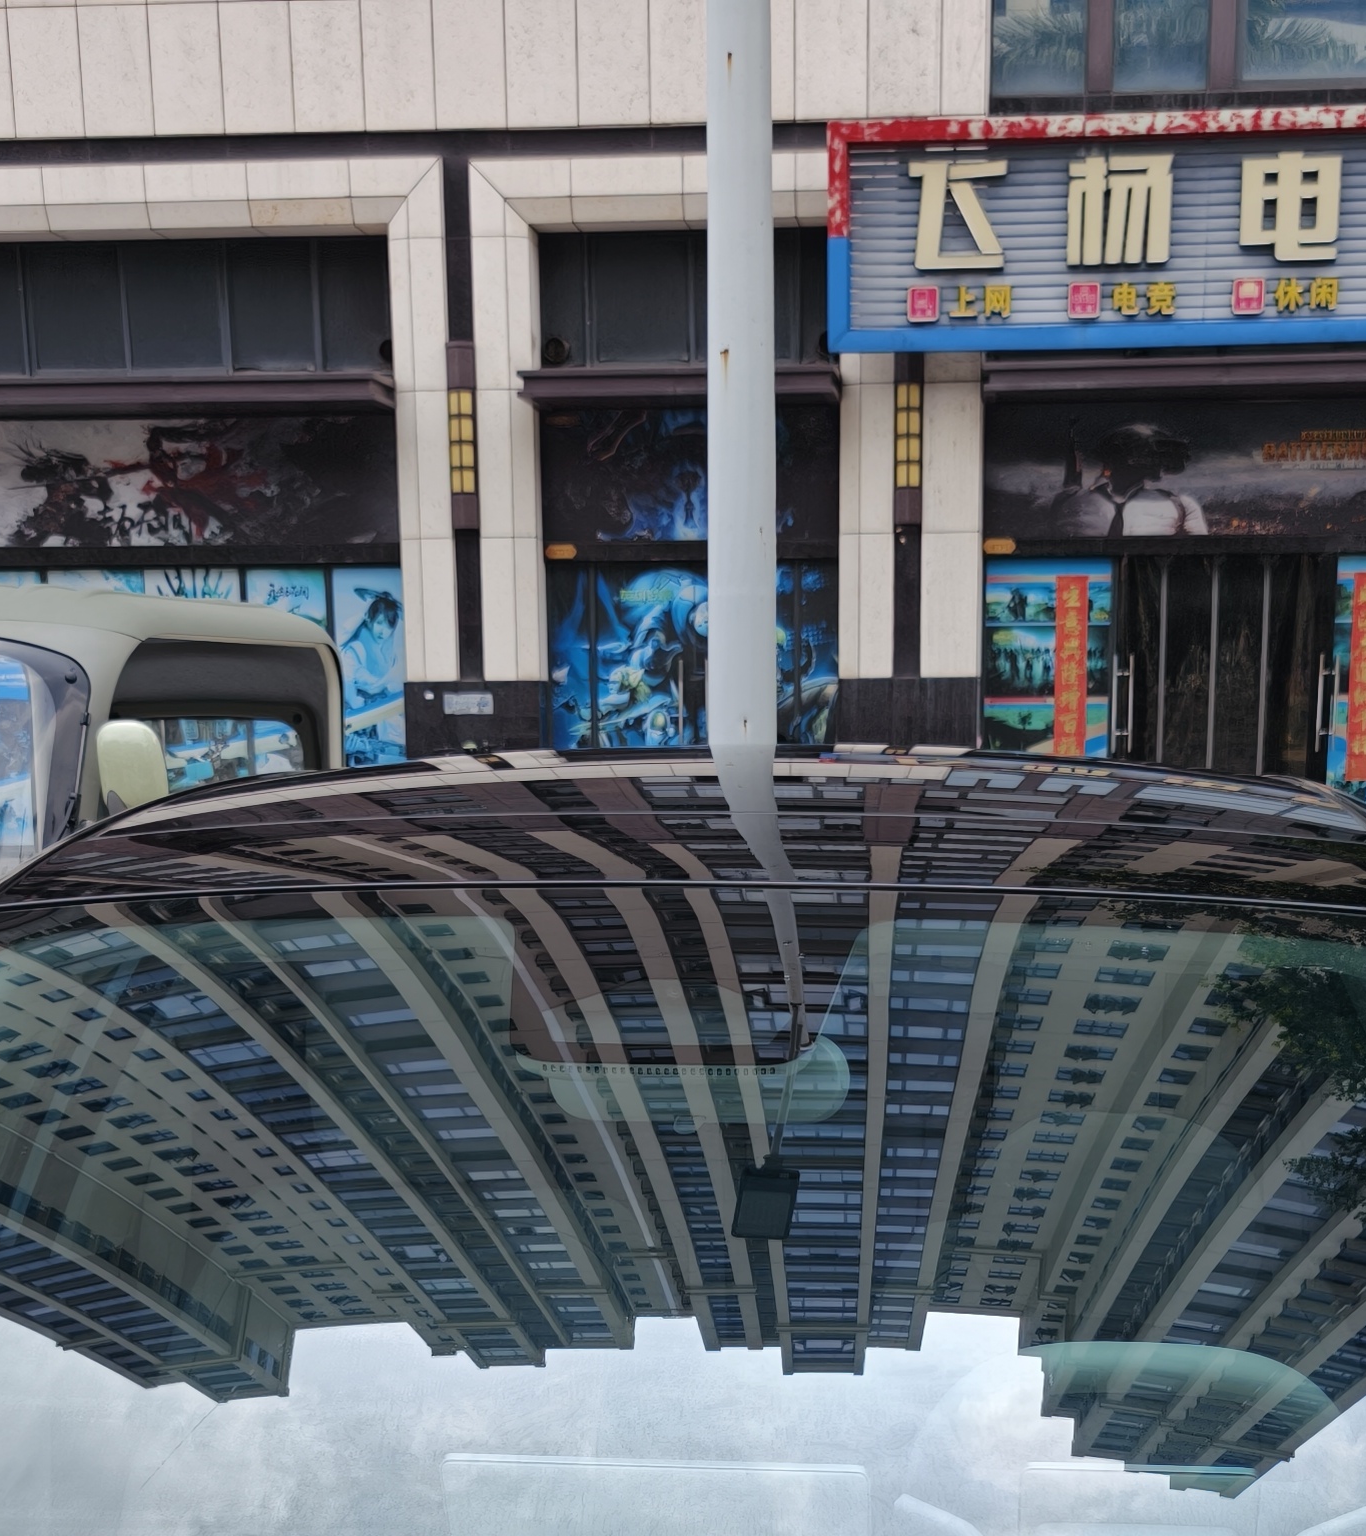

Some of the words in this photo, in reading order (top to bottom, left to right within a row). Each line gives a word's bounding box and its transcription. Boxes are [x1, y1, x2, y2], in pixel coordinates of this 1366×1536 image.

[948, 285, 1012, 318] 上网
[1112, 281, 1176, 316] 电竞
[1274, 277, 1339, 313] 休闲
